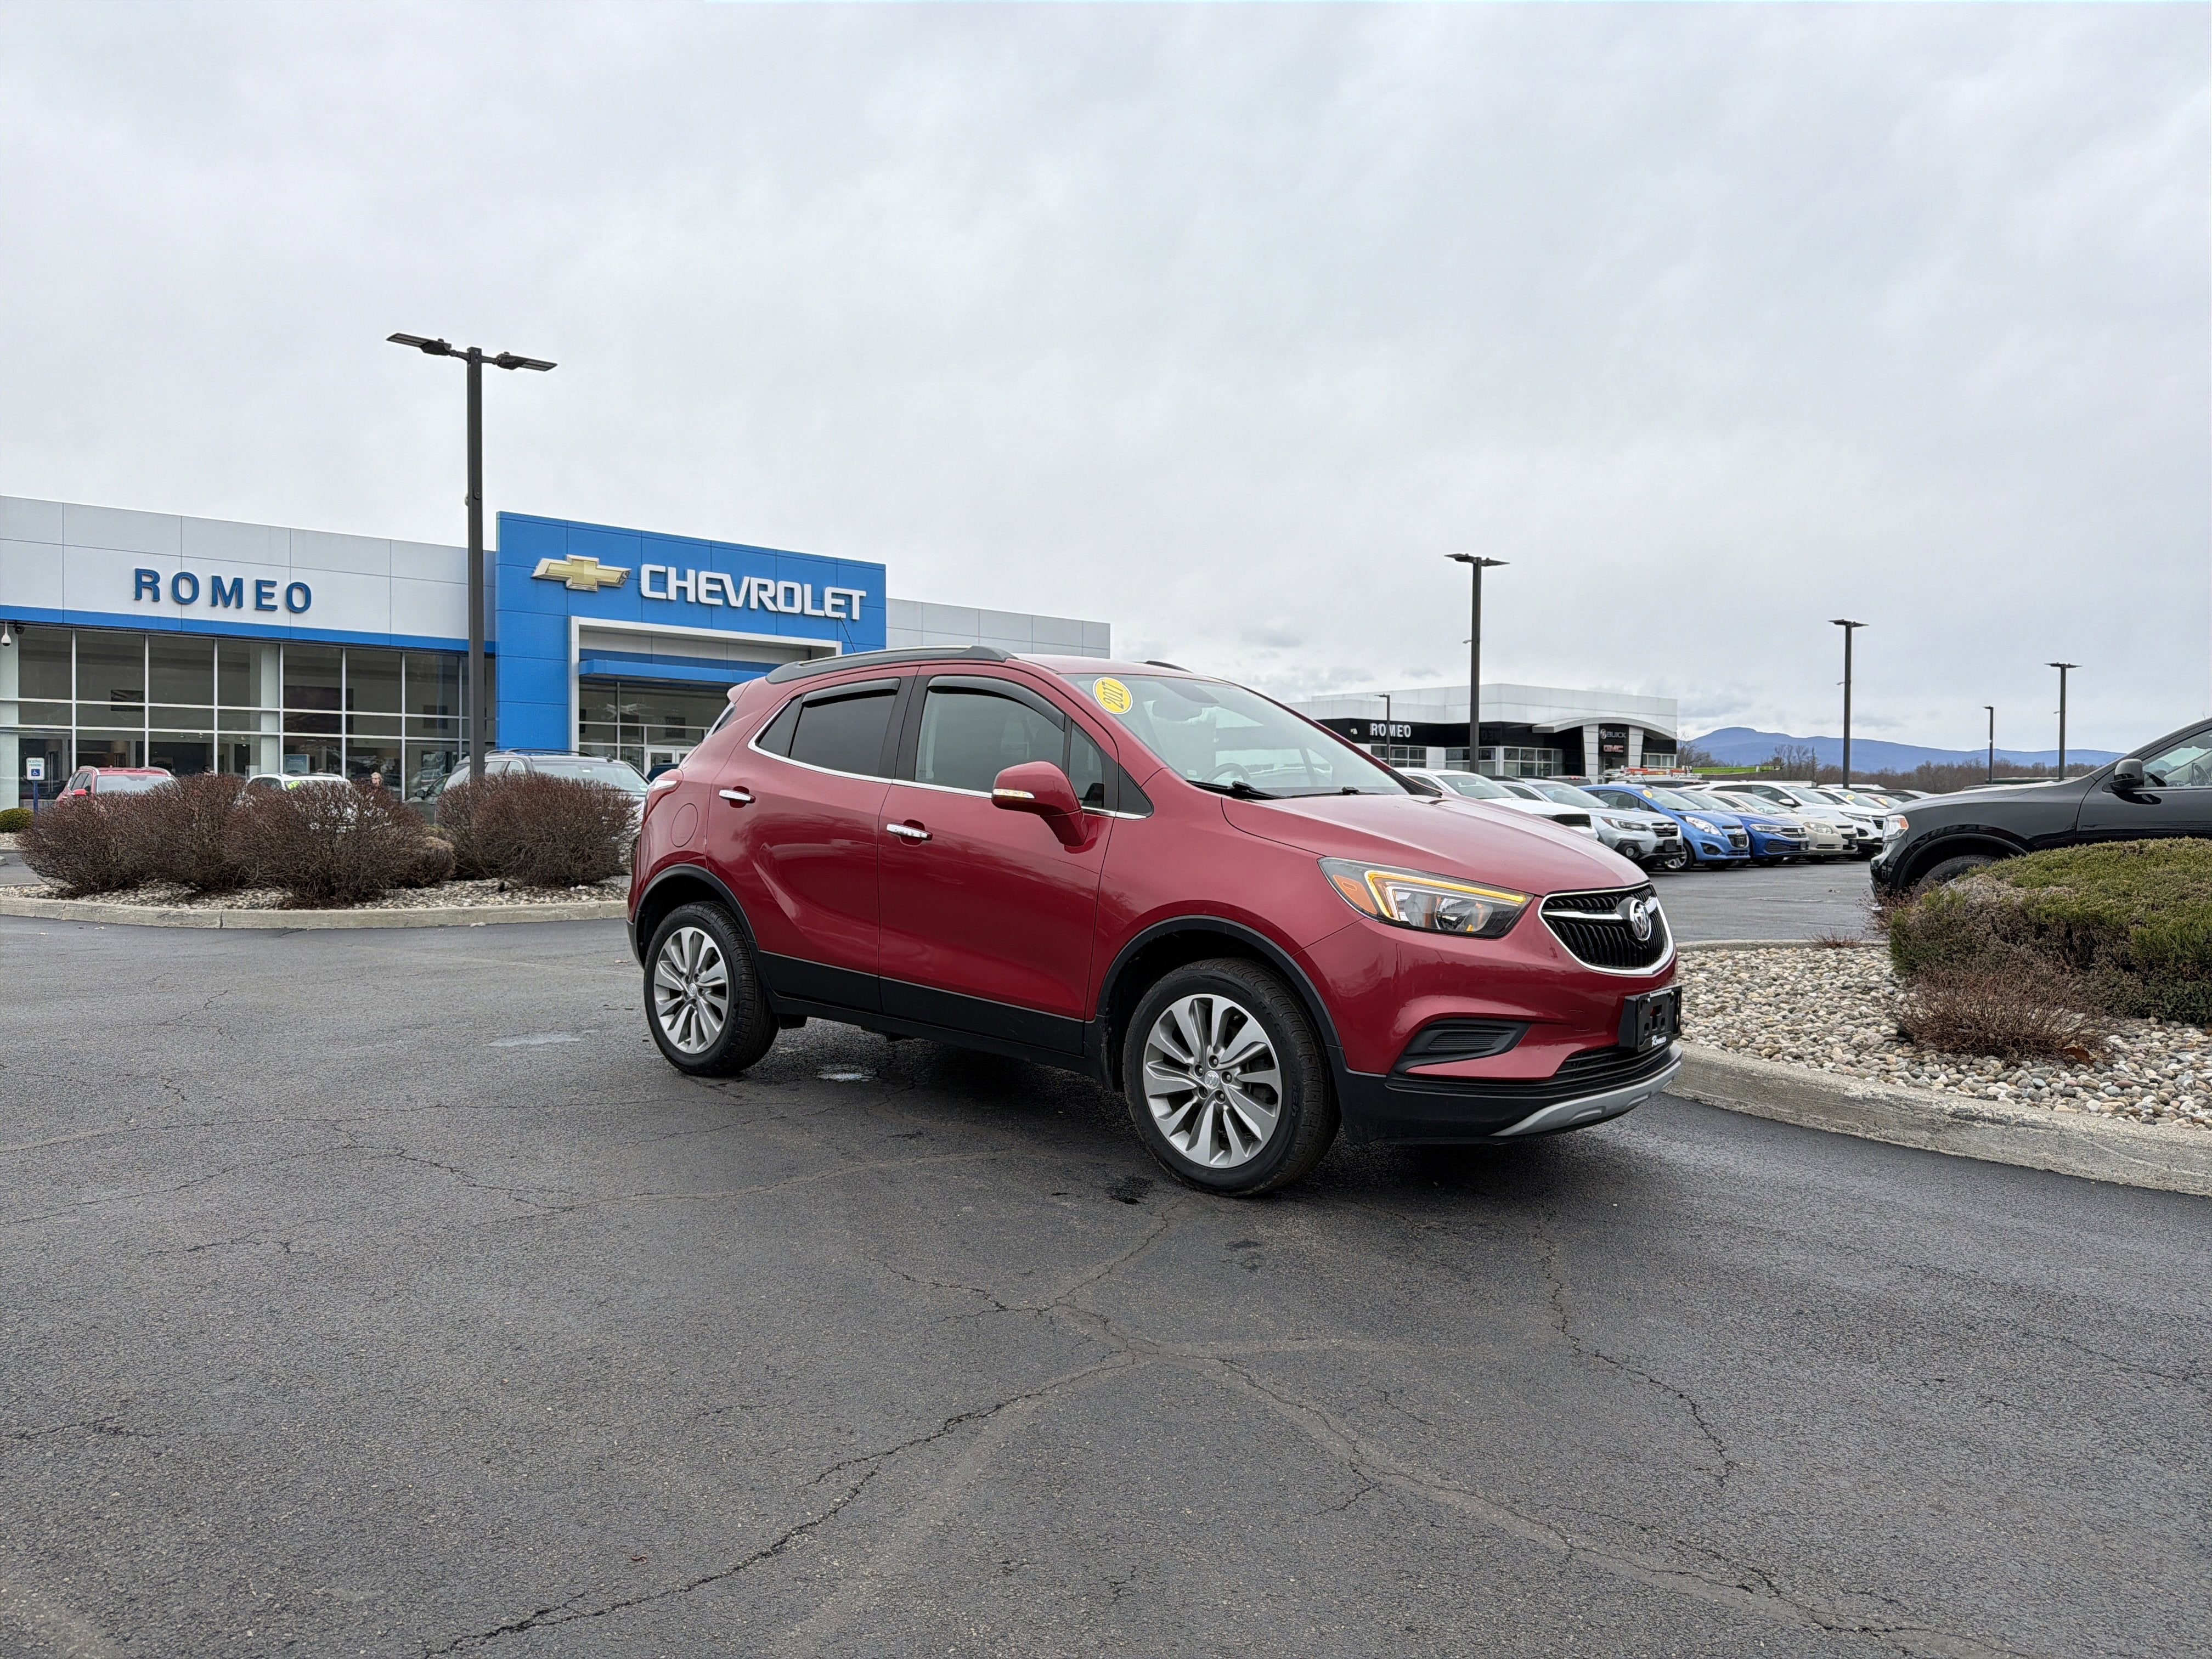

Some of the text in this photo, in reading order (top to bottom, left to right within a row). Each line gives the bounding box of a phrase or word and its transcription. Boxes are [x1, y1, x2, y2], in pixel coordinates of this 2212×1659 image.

[134, 568, 312, 613] ROMEO
[641, 564, 866, 620] CHEVROLET
[1102, 681, 1124, 709] 2017
[1369, 723, 1411, 738] ROMEO
